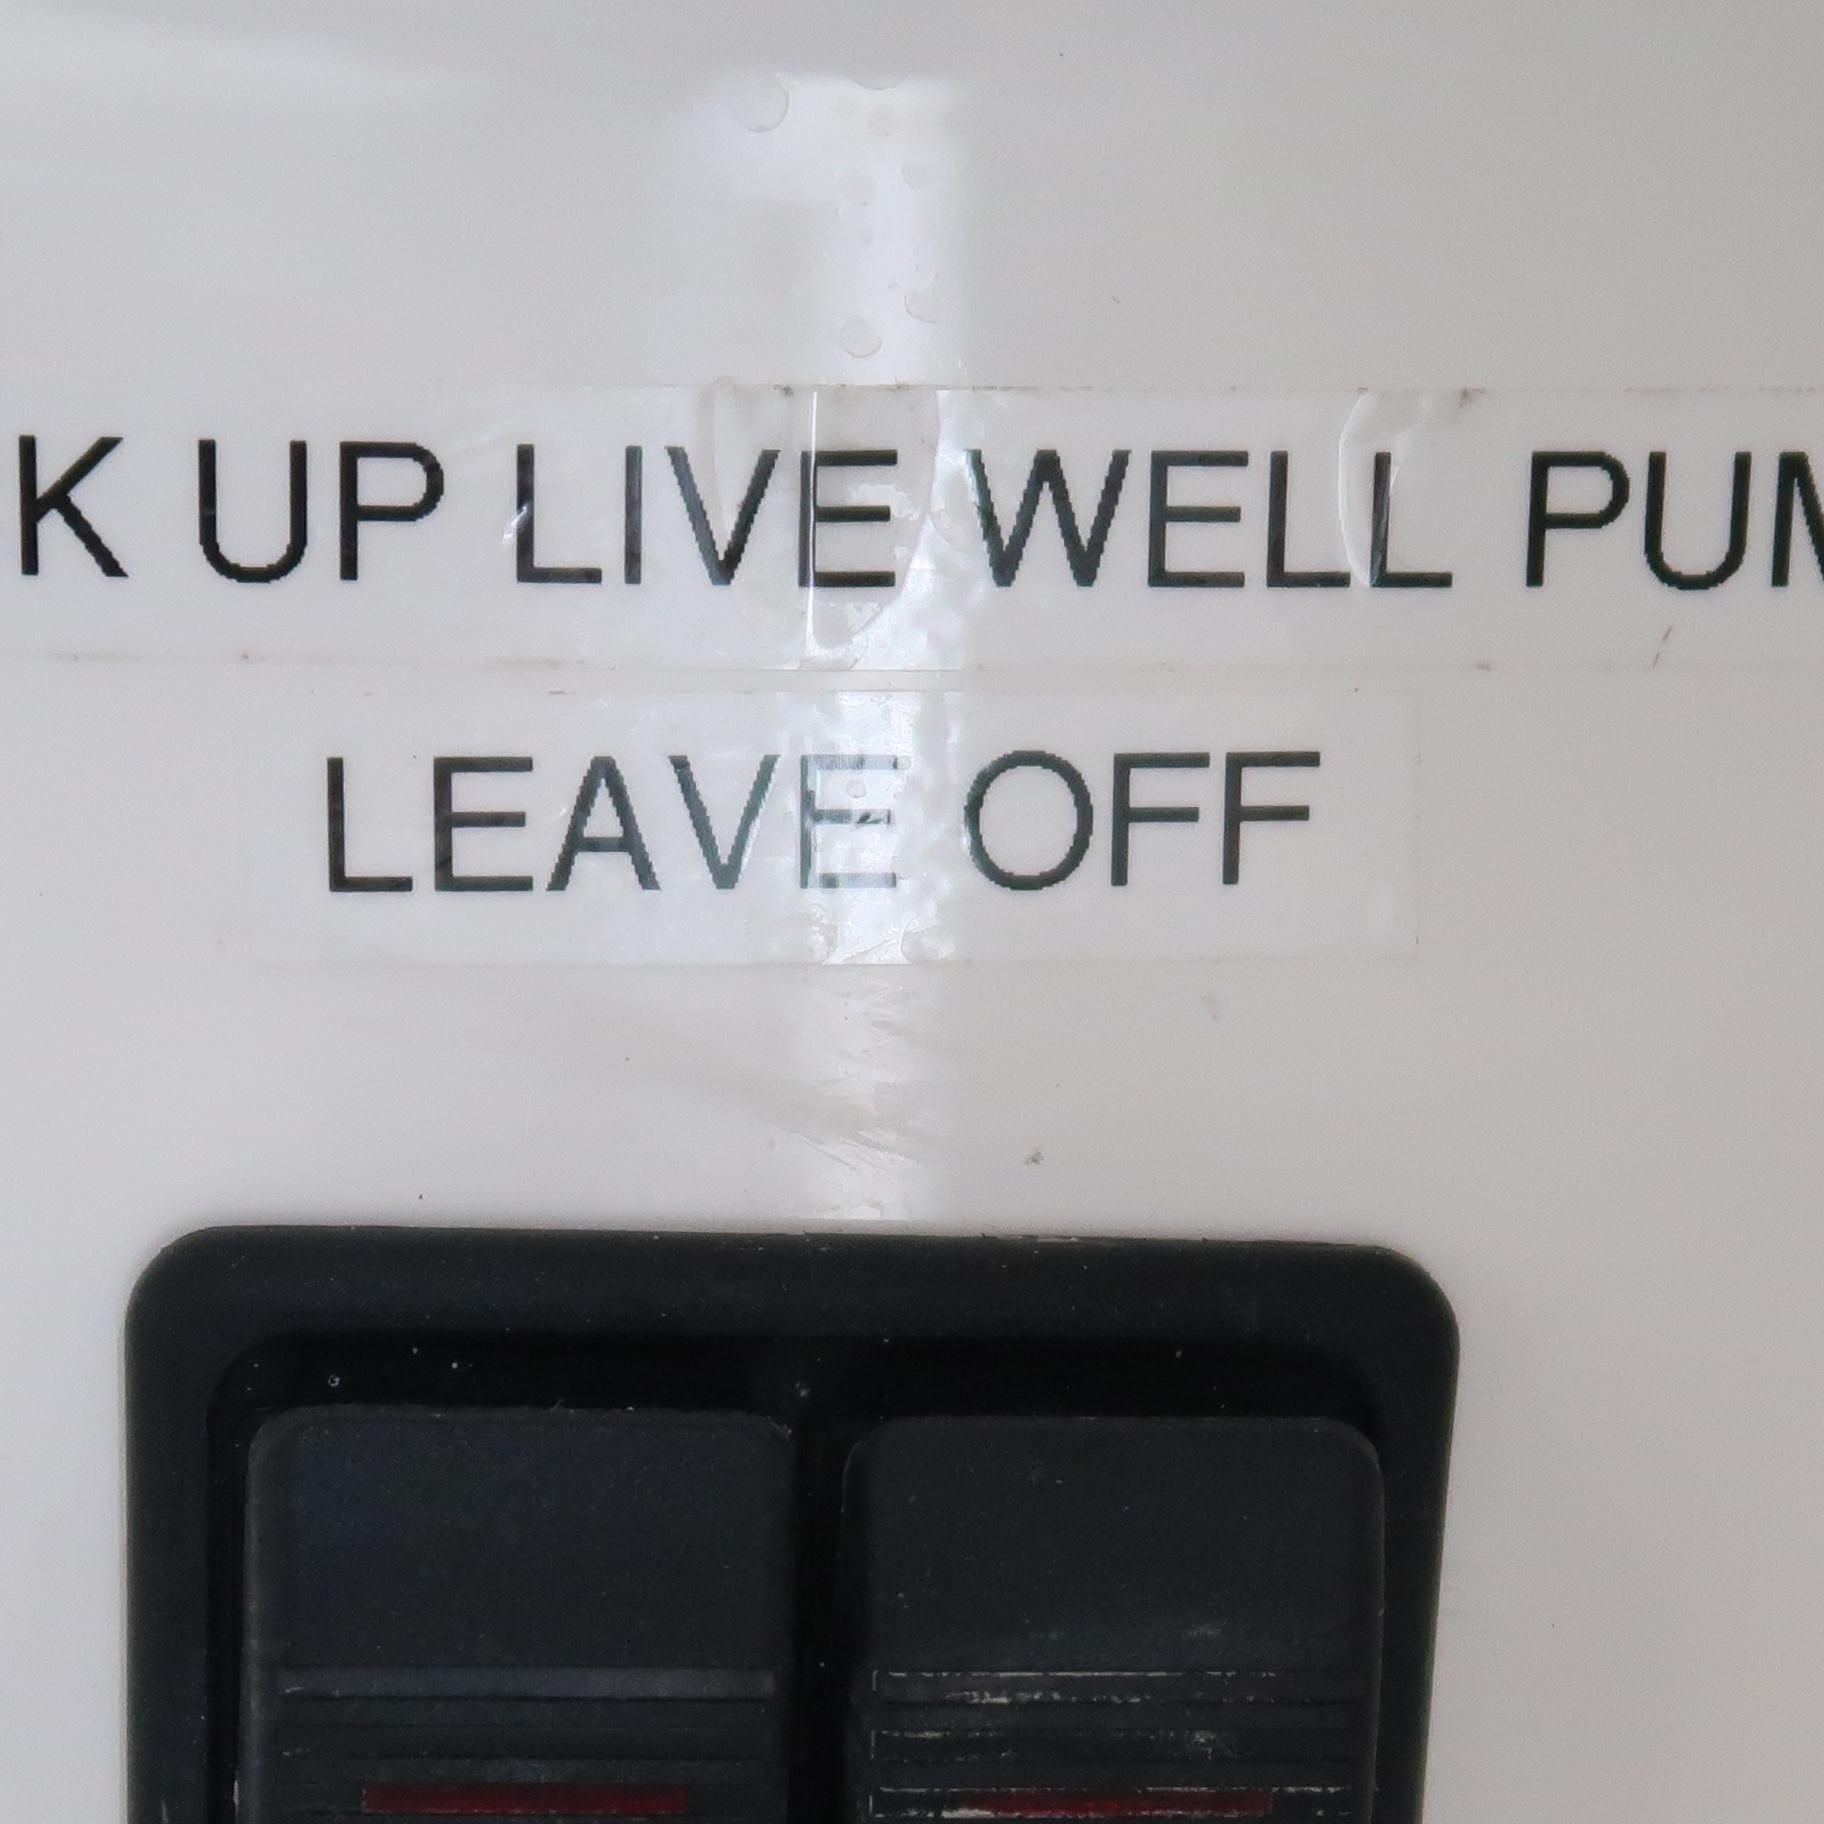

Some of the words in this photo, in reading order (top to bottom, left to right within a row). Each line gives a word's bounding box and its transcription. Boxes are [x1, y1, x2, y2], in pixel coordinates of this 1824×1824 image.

[199, 440, 443, 583] UP
[517, 446, 898, 587] LIVE
[971, 451, 1452, 588] WELL
[328, 755, 899, 892] LEAVE
[966, 752, 1319, 890] OFF
